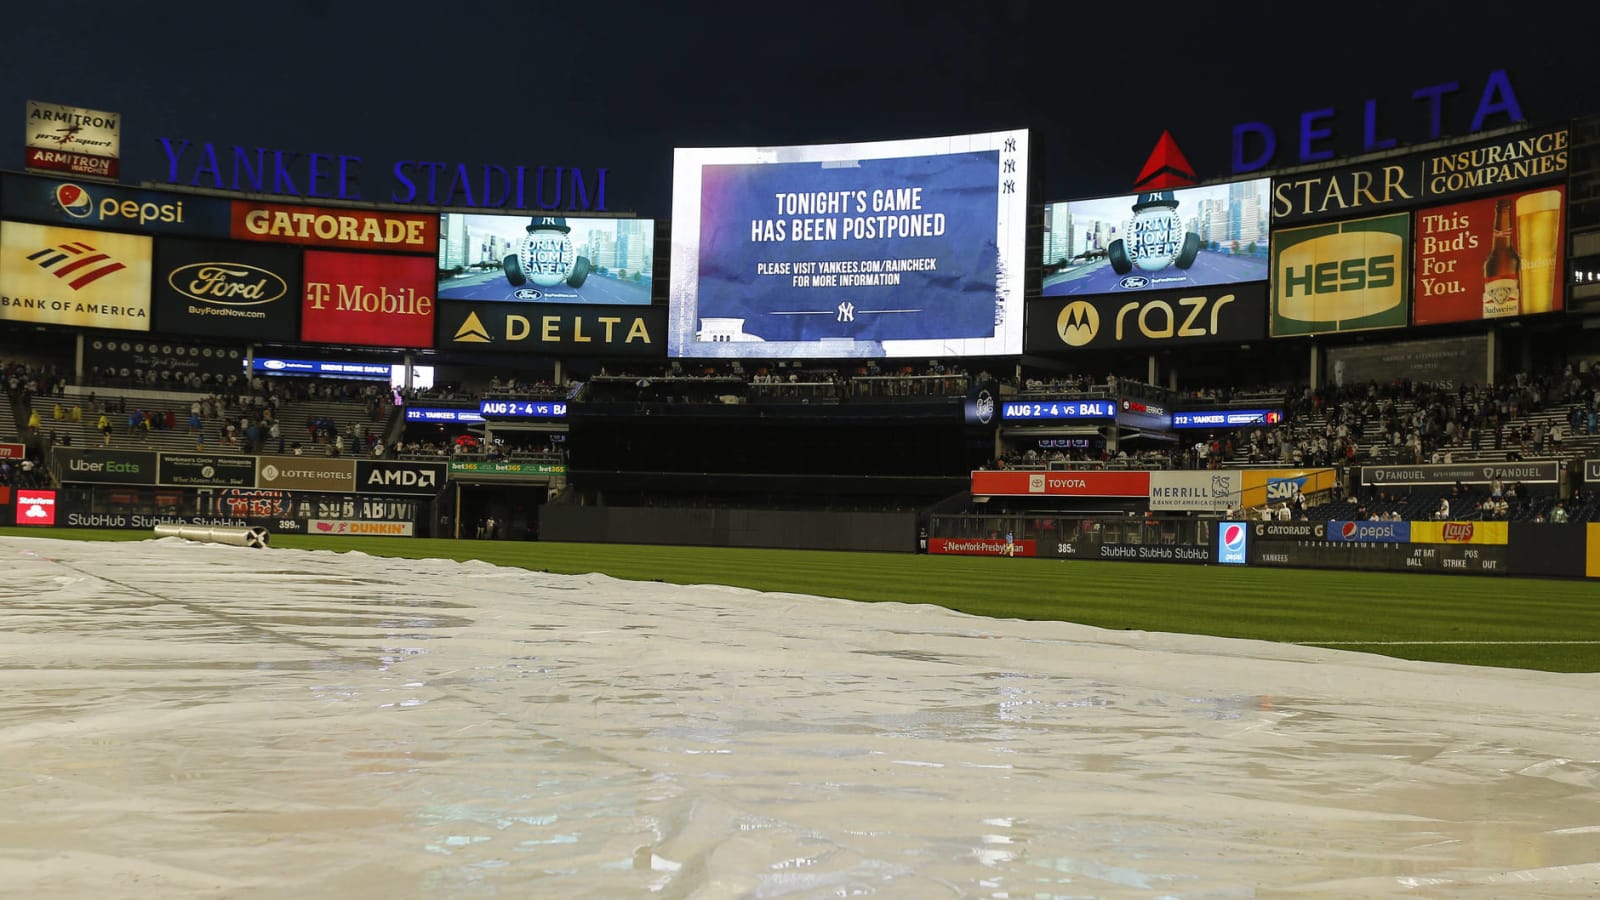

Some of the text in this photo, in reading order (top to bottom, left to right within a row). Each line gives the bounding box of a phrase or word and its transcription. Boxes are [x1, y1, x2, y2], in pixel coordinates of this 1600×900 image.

[31, 109, 116, 129] ARMITRON
[1232, 68, 1525, 173] DELTA
[1432, 130, 1568, 175] INSURANCE
[33, 151, 110, 169] ARMITRON
[156, 138, 611, 212] YANKEE STADIUM
[1431, 152, 1568, 194] COMPANIES
[1274, 165, 1414, 218] STARR
[776, 188, 923, 216] TONIGHT'S GAME
[99, 198, 184, 225] pepsi
[245, 210, 427, 245] GATORADE
[751, 213, 945, 243] HAS BEEN POSTPONED
[1134, 217, 1178, 232] DRIVE
[1424, 212, 1470, 235] This
[1134, 231, 1178, 245] HOME
[1424, 231, 1479, 256] Bud's
[528, 240, 568, 252] DRIVE
[1131, 242, 1178, 258] SAFELY
[528, 252, 568, 263] HOME
[525, 262, 569, 274] SAFELY
[758, 258, 937, 275] PLEASE VISIT YANKEES.COM/RAINCHECK
[1423, 257, 1457, 276] For
[793, 273, 900, 288] FOR MORE INFORMATION
[1285, 254, 1396, 298] HESS
[190, 267, 265, 300] Ford
[1422, 278, 1466, 298] You.
[337, 285, 432, 316] Mobile
[1, 297, 146, 318] BANK OF AMERICA
[189, 305, 266, 319] BuyFordNow.com
[1116, 294, 1235, 341] razr
[506, 316, 651, 344] DELTA
[408, 411, 421, 419] 212
[483, 403, 506, 414] AUG
[509, 404, 516, 414] 2
[525, 404, 533, 414] 4
[537, 406, 548, 414] VS
[1007, 405, 1031, 417] AUG
[1034, 405, 1041, 417] 2
[1050, 405, 1059, 417] 4
[1063, 406, 1075, 415] VS
[1080, 404, 1103, 415] BAL
[1175, 416, 1188, 425] 212
[1193, 415, 1225, 424] YANKEES
[70, 459, 140, 474] Uber Eats
[452, 462, 478, 470] bet365
[495, 463, 522, 472] bet365
[539, 465, 565, 473] bet365
[282, 470, 353, 481] LOTTE HOTELS
[368, 470, 417, 486] AMD
[1386, 471, 1425, 480] FANDUEL
[1496, 468, 1542, 478] FANDUEL
[1049, 479, 1086, 489] TOYOTA
[1153, 487, 1209, 498] MERRILL
[1268, 483, 1299, 499] SAP
[68, 514, 126, 527] StubHub
[131, 515, 187, 527] StubHub
[193, 517, 247, 528] StubHub
[279, 520, 295, 529] 399
[1268, 526, 1311, 535] GATORADE
[1360, 526, 1394, 539] pepsi
[1058, 543, 1072, 553] 385
[1101, 546, 1137, 557] StubHub
[1139, 547, 1172, 559] StubHub
[1175, 548, 1209, 560] StubHub
[1414, 549, 1435, 558] AT BAT
[1263, 554, 1289, 563] YANKEES
[1465, 551, 1479, 559] POS
[1407, 558, 1422, 567] BALL
[1443, 559, 1467, 569] STRIKE
[1483, 560, 1496, 569] OUT
